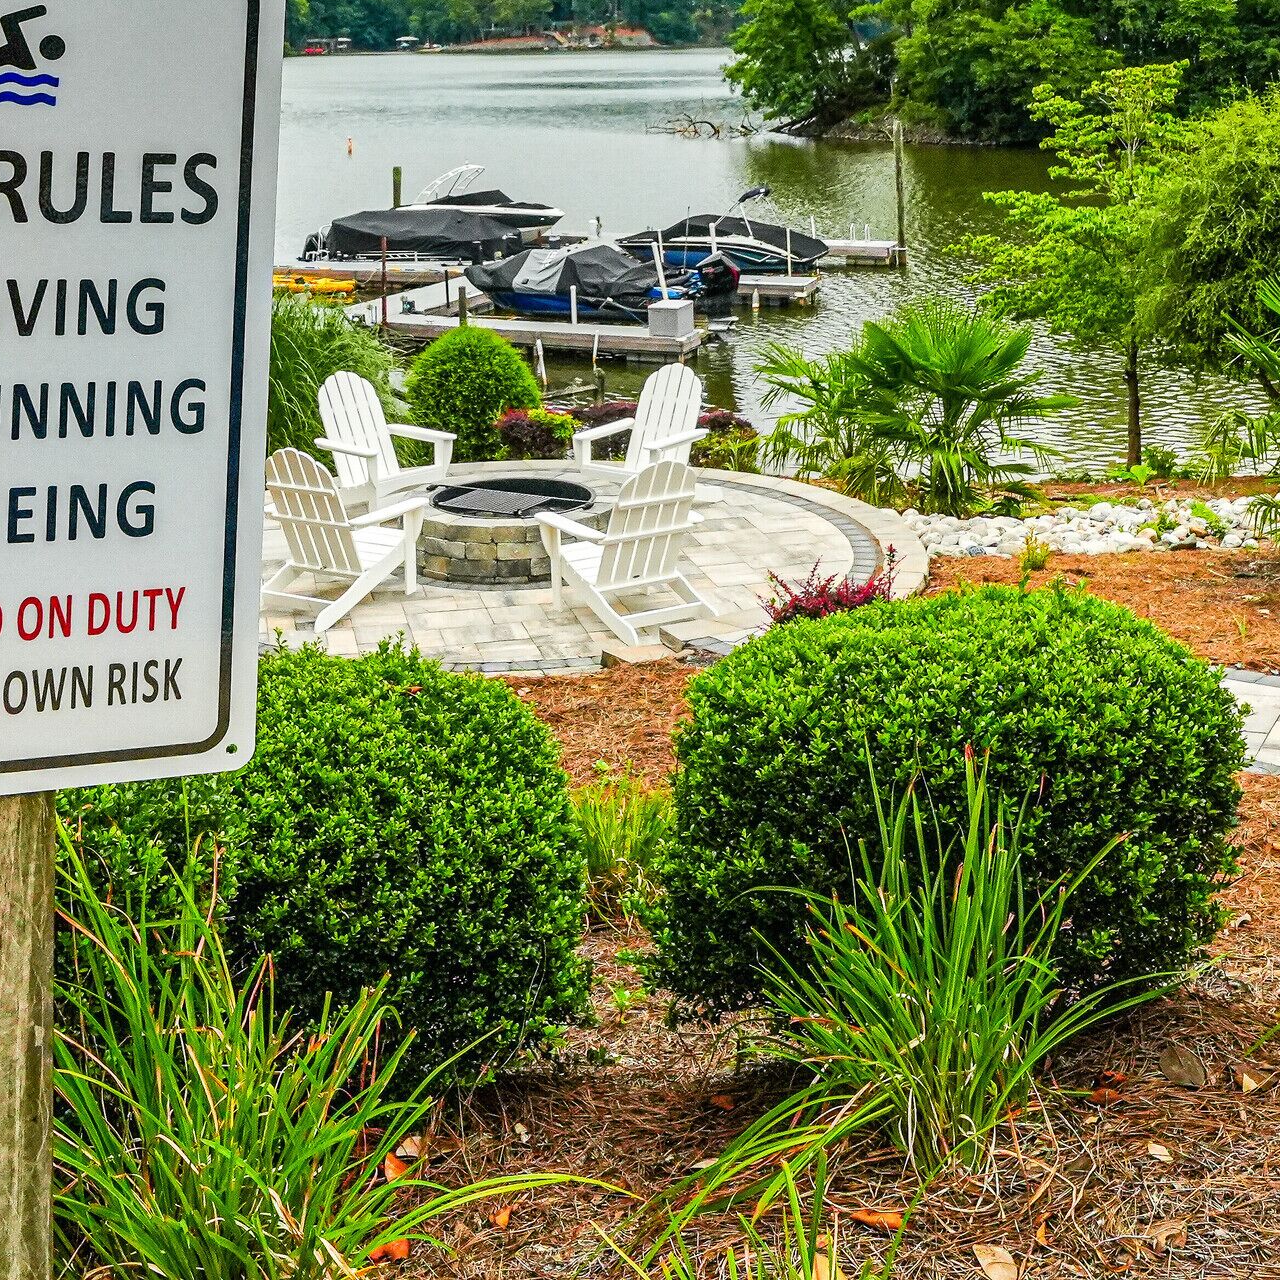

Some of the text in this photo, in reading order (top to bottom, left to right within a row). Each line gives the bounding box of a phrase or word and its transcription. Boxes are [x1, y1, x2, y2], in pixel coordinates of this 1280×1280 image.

[17, 595, 72, 641] ON
[88, 587, 185, 635] DUTY
[3, 665, 93, 715] OWN
[108, 658, 182, 705] RISK
